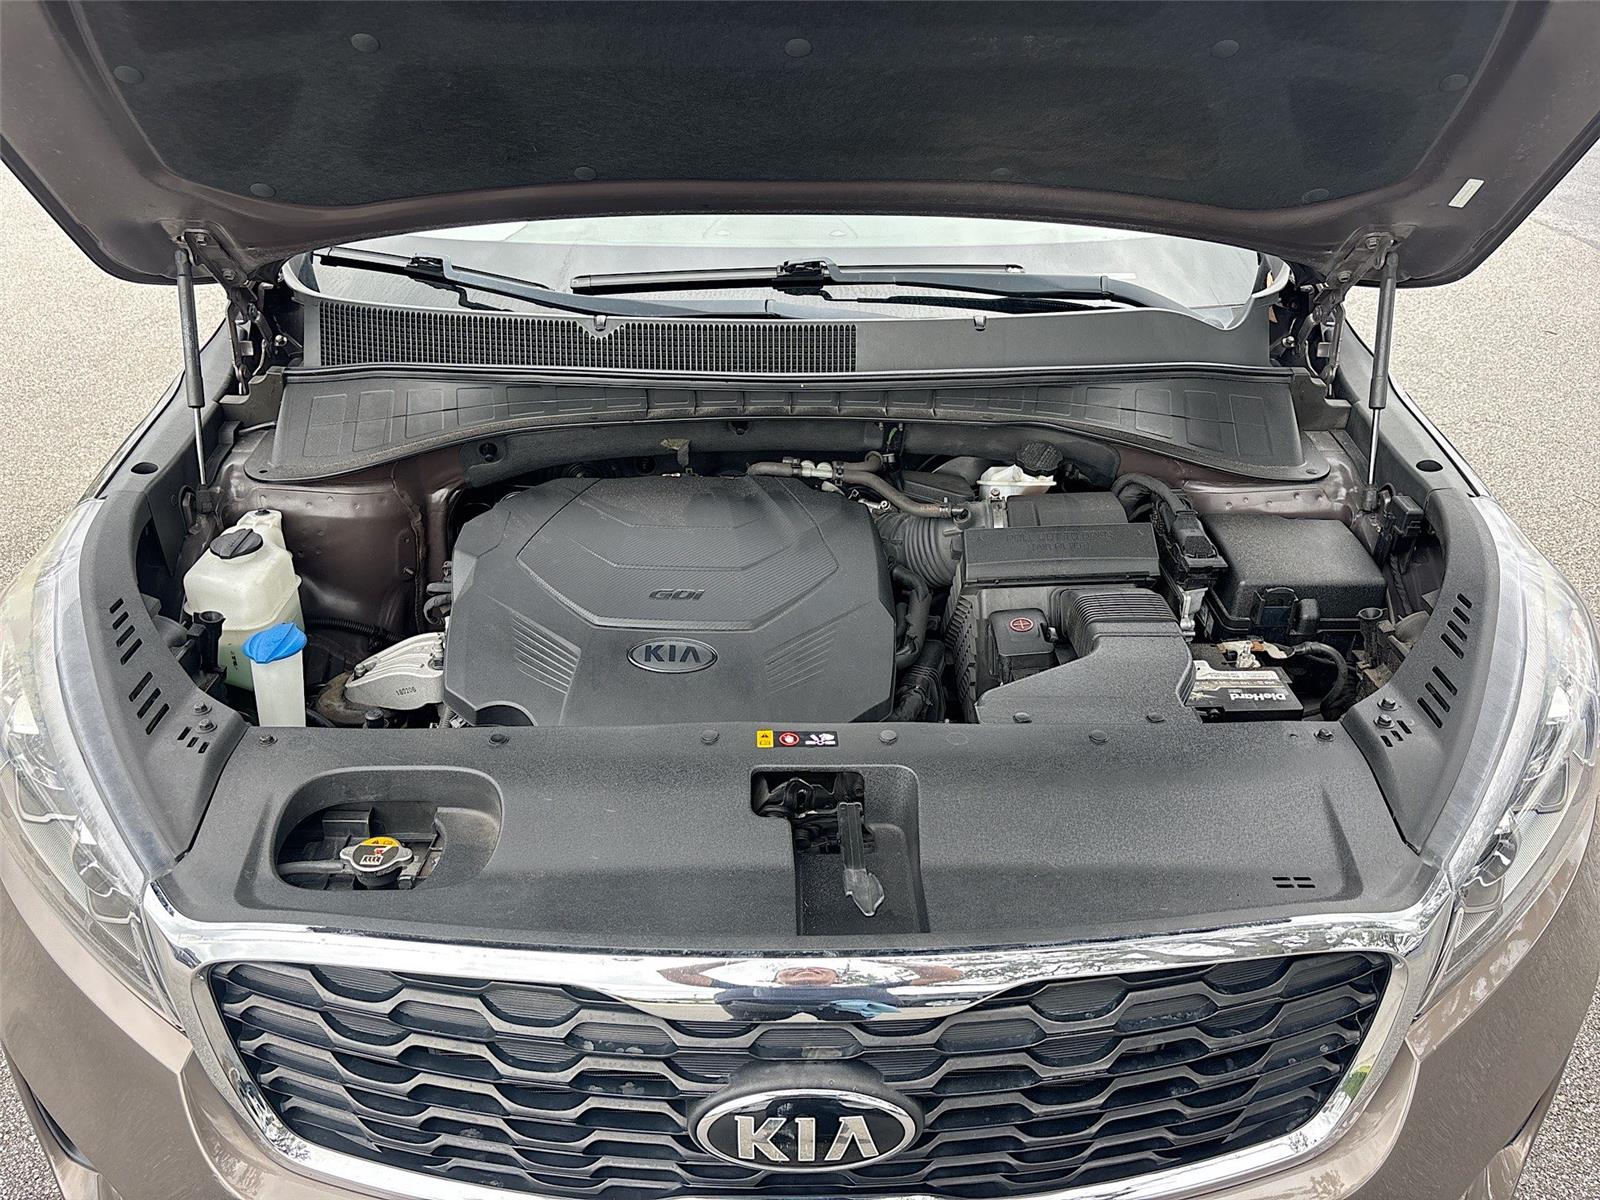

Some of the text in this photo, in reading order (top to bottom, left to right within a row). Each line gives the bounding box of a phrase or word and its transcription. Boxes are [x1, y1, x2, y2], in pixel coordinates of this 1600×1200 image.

[644, 644, 702, 663] KIA
[1230, 693, 1287, 701] DieHard
[734, 1115, 880, 1162] KIA
